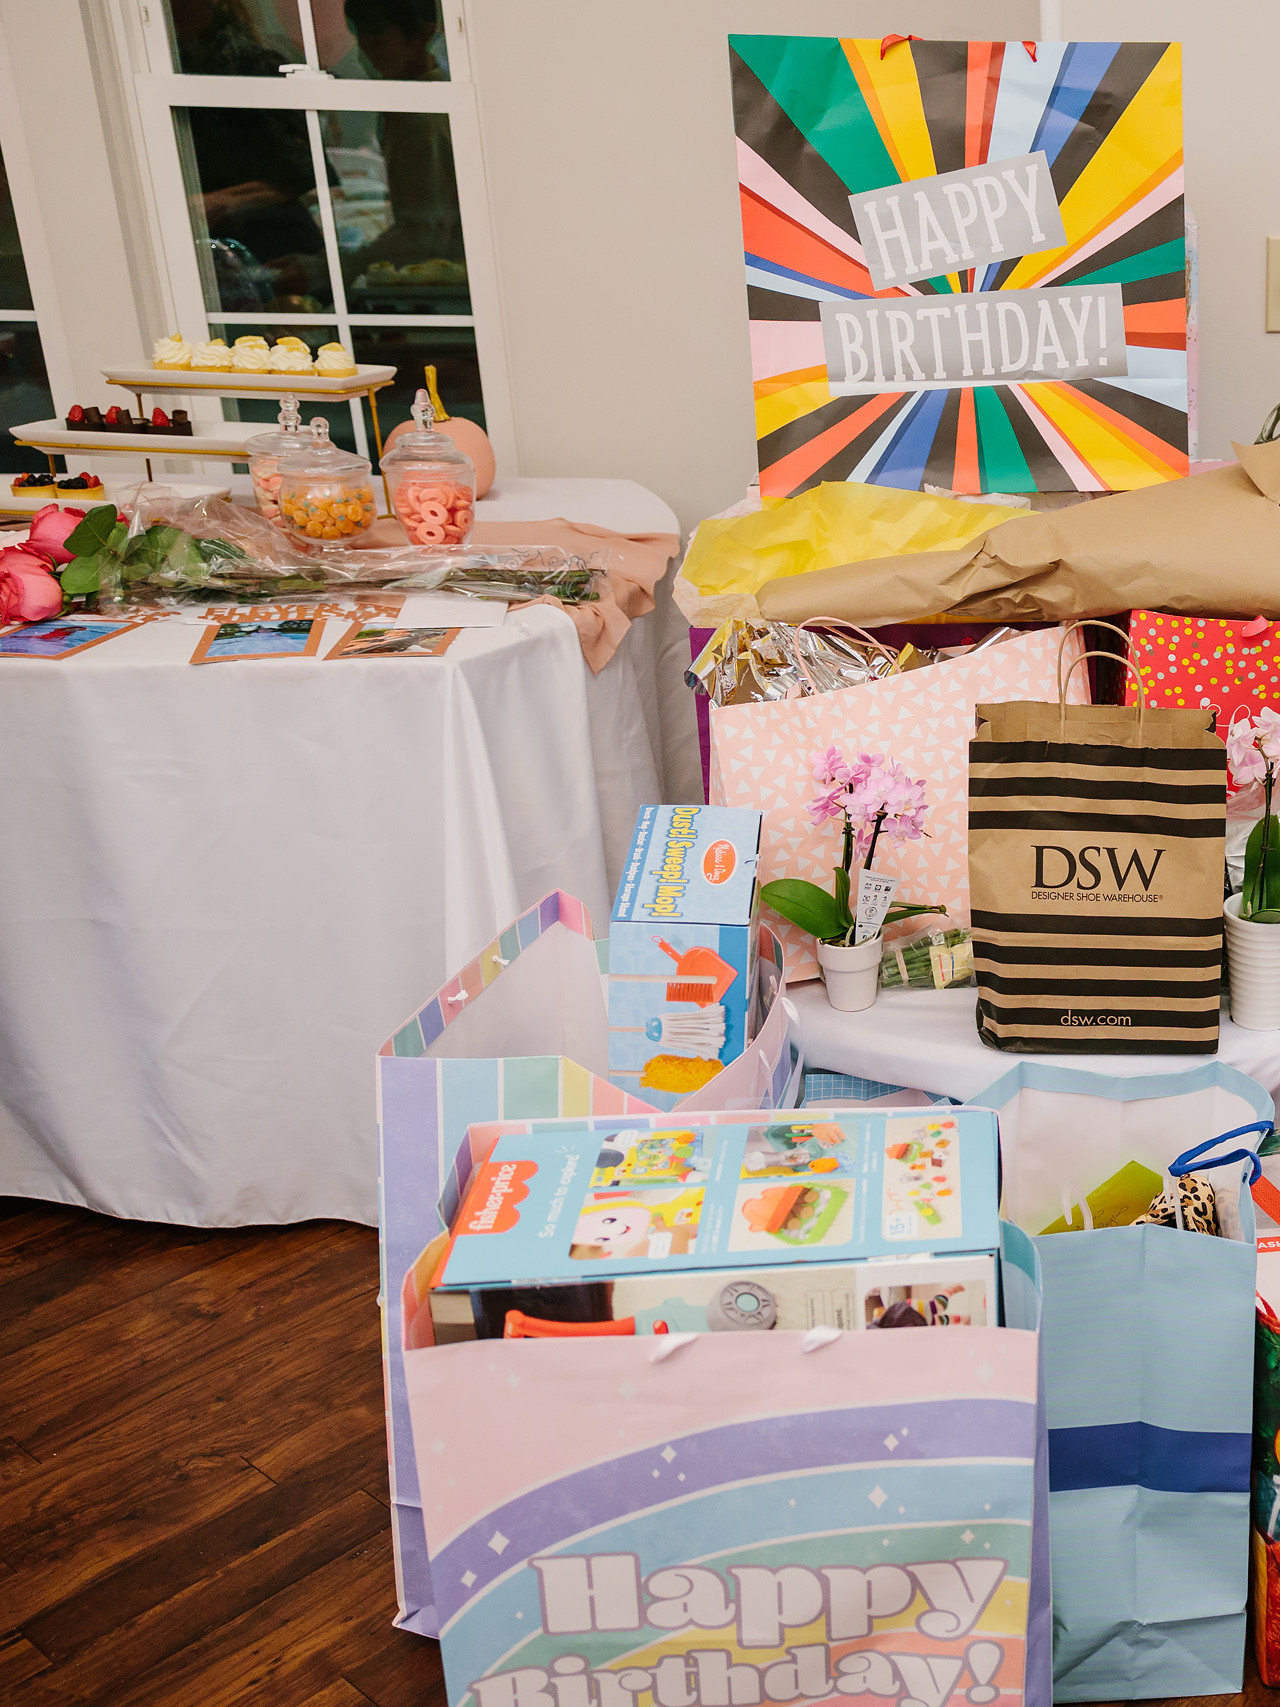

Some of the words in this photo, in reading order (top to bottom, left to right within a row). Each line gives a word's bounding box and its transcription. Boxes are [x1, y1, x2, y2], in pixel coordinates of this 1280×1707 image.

[864, 163, 1047, 281] HAPPY
[835, 295, 1110, 384] BIRTHDAY!
[668, 807, 700, 839] Dust!
[651, 840, 694, 883] Sweep!
[1030, 845, 1167, 892] DSW
[643, 885, 684, 917] Mop!
[1031, 891, 1075, 901] DESIGNER
[1076, 892, 1101, 902] SHOE
[1060, 1010, 1132, 1026] dsw.com
[553, 1186, 568, 1197] to
[546, 1197, 564, 1222] much
[538, 1223, 556, 1239] So
[529, 1552, 1008, 1649] Happy
[468, 1640, 1005, 1707] Birthday!
